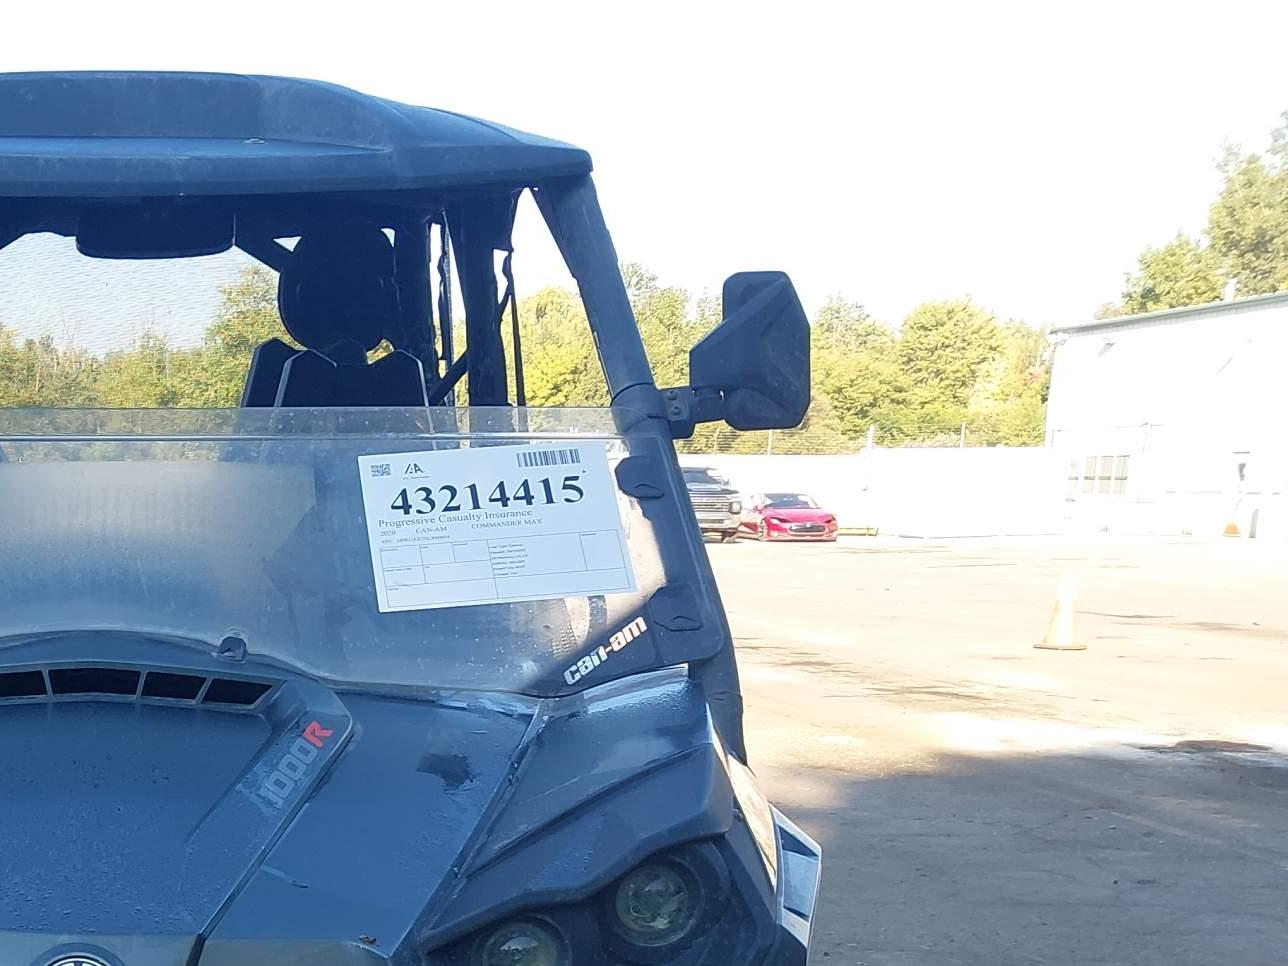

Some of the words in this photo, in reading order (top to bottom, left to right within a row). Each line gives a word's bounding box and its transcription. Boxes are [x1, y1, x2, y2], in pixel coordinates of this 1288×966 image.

[378, 518, 436, 528] Progressive
[438, 512, 482, 524] Casualty
[484, 510, 533, 520] Insurance
[390, 475, 585, 516] 43214415
[563, 616, 648, 685] can-am
[256, 721, 333, 809] 1000R
